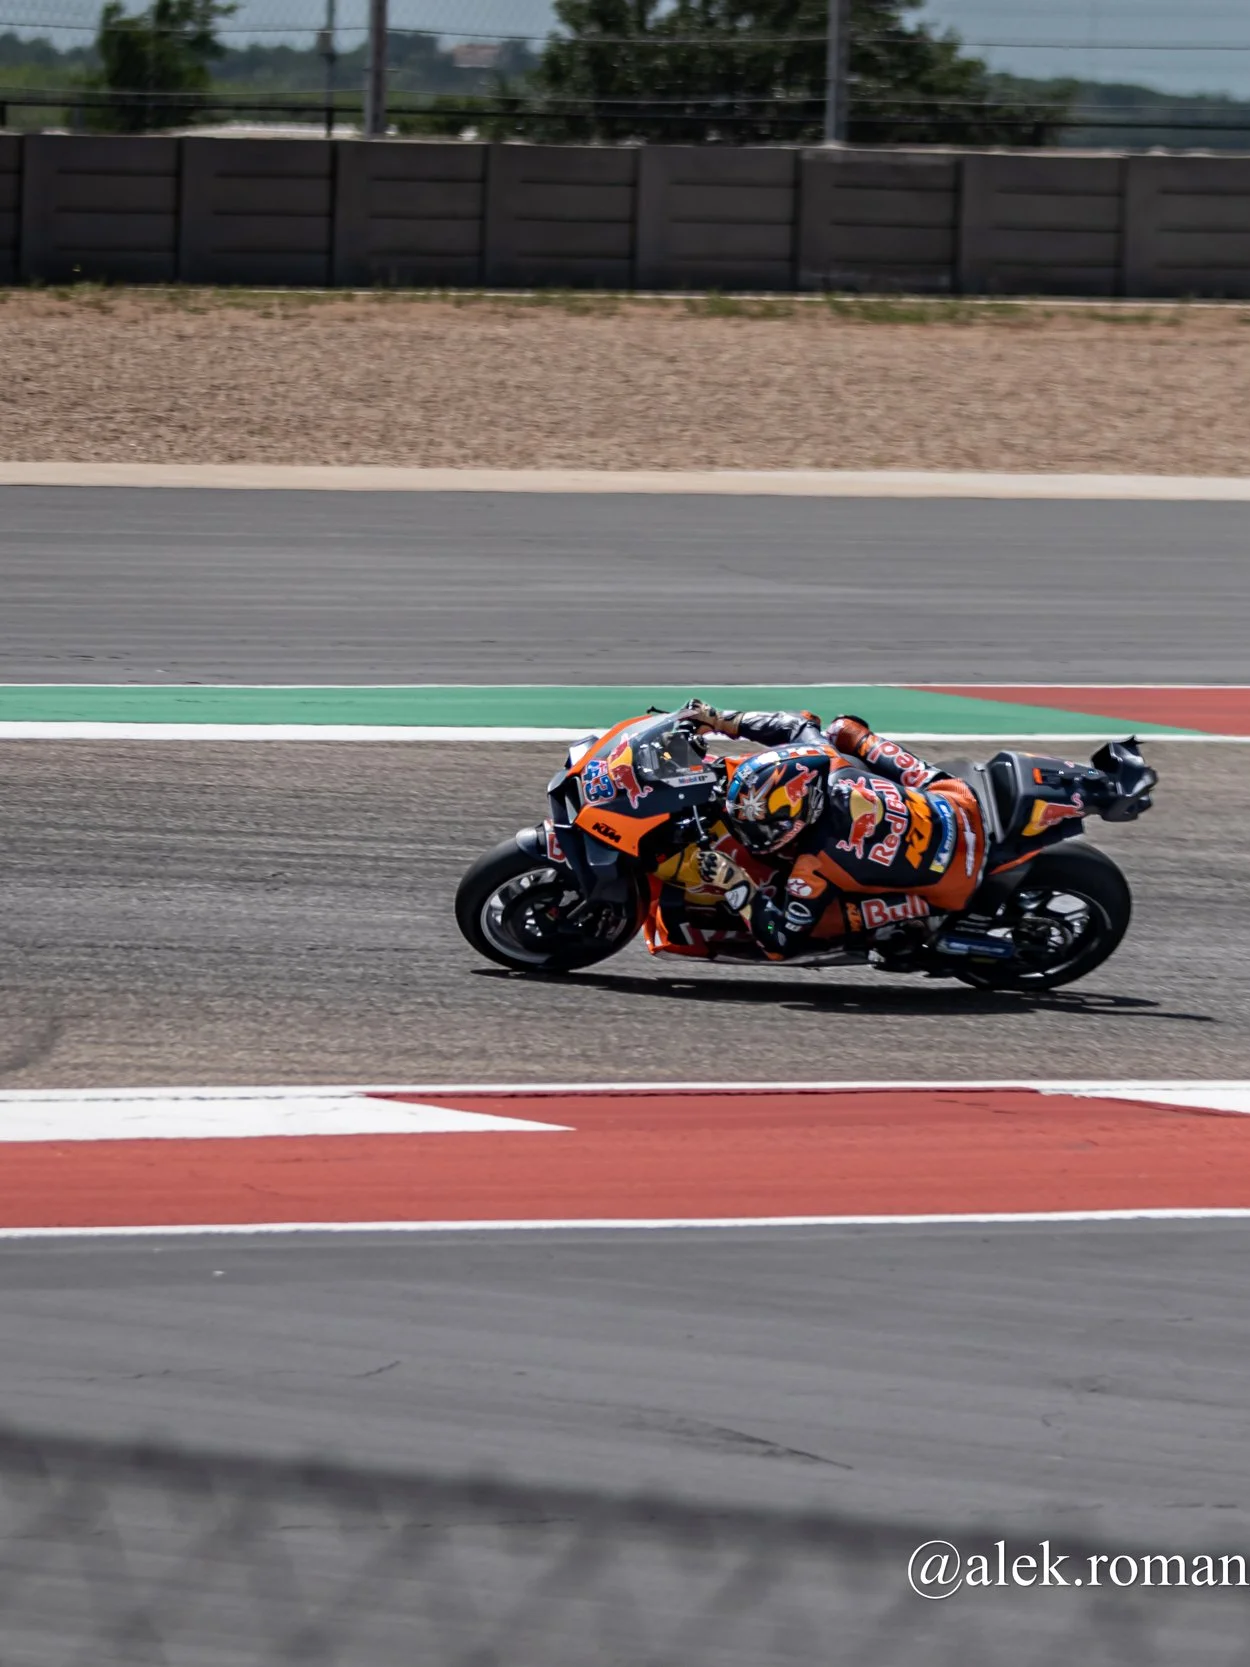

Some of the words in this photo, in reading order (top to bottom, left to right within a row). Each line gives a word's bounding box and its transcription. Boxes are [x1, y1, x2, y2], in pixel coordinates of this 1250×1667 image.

[582, 760, 616, 803] 43
[591, 822, 622, 843] KTM
[860, 894, 930, 930] Bull
